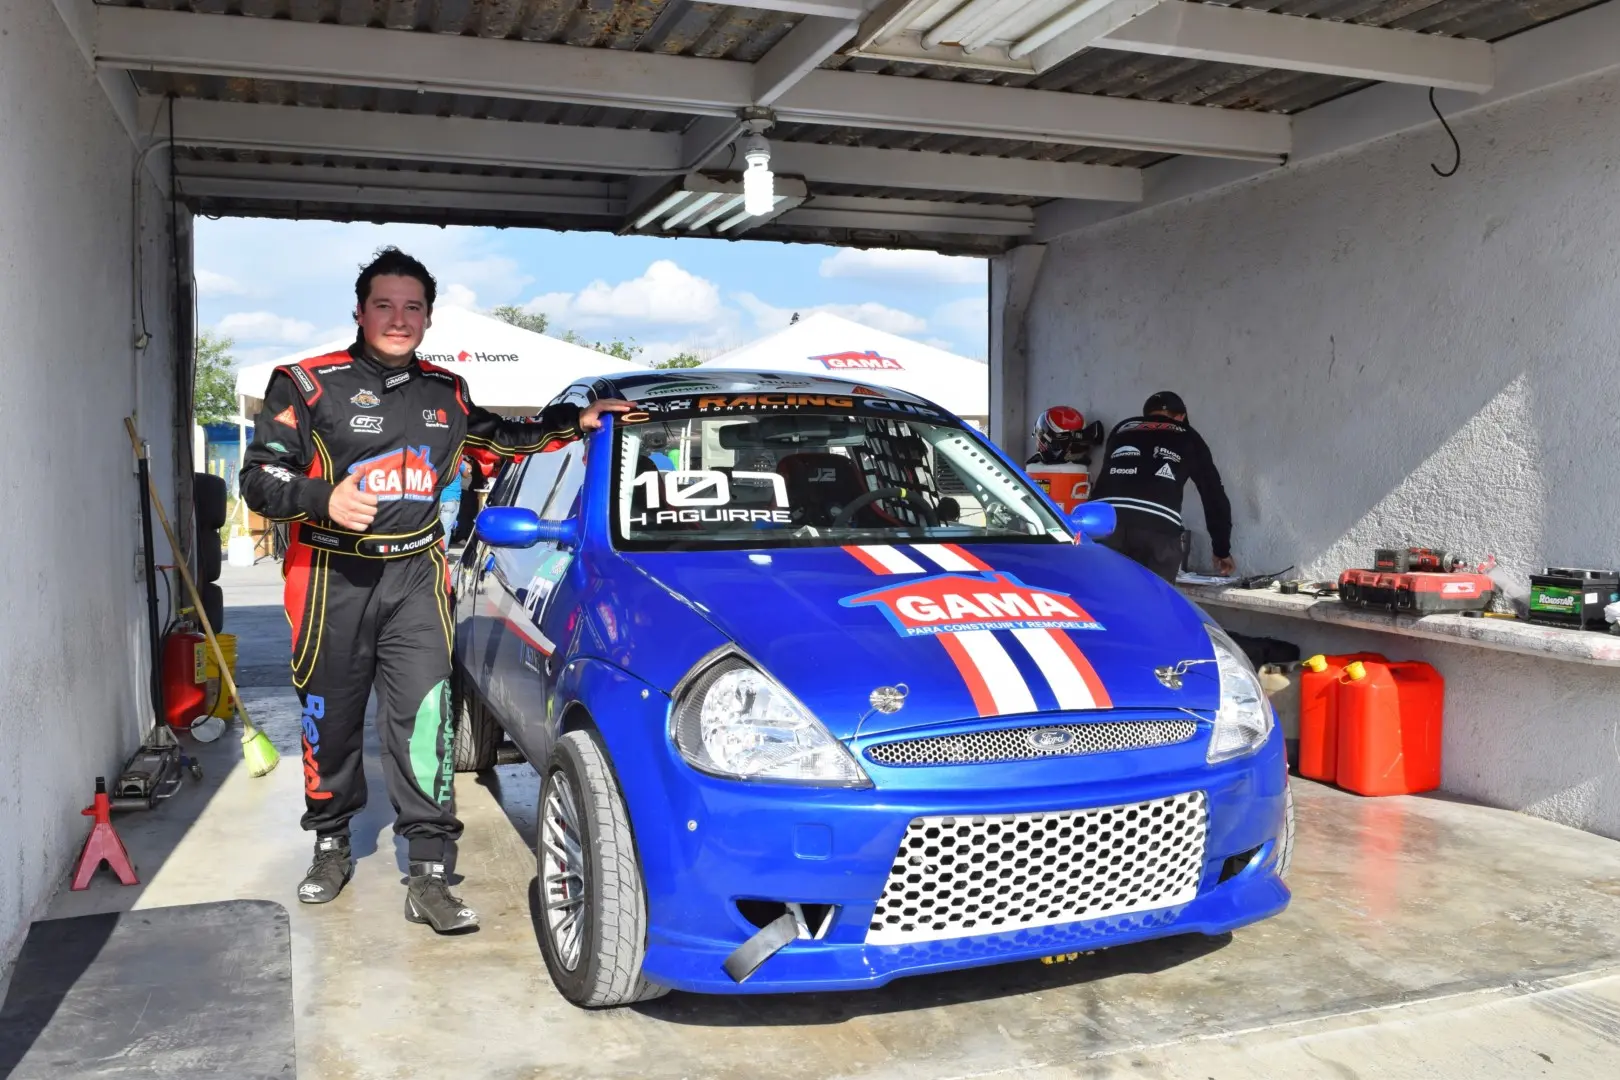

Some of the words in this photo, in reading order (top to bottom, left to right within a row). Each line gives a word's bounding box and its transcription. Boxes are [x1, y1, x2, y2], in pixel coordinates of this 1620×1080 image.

[475, 352, 519, 362] Home
[828, 358, 898, 369] GAMA
[698, 394, 853, 408] RACING
[863, 399, 940, 417] CUP
[700, 404, 800, 412] MONTERREY
[1110, 467, 1138, 475] Bexel
[368, 468, 433, 492] GAMA
[631, 470, 790, 509] 107
[656, 508, 792, 524] AGUIRRE
[402, 534, 434, 551] AGUIRRE
[896, 593, 1080, 621] GAMA
[907, 627, 942, 636] PARA
[943, 622, 1014, 633] CONSTRUIR
[1026, 621, 1100, 630] REMODELAR
[1039, 732, 1064, 746] Ford
